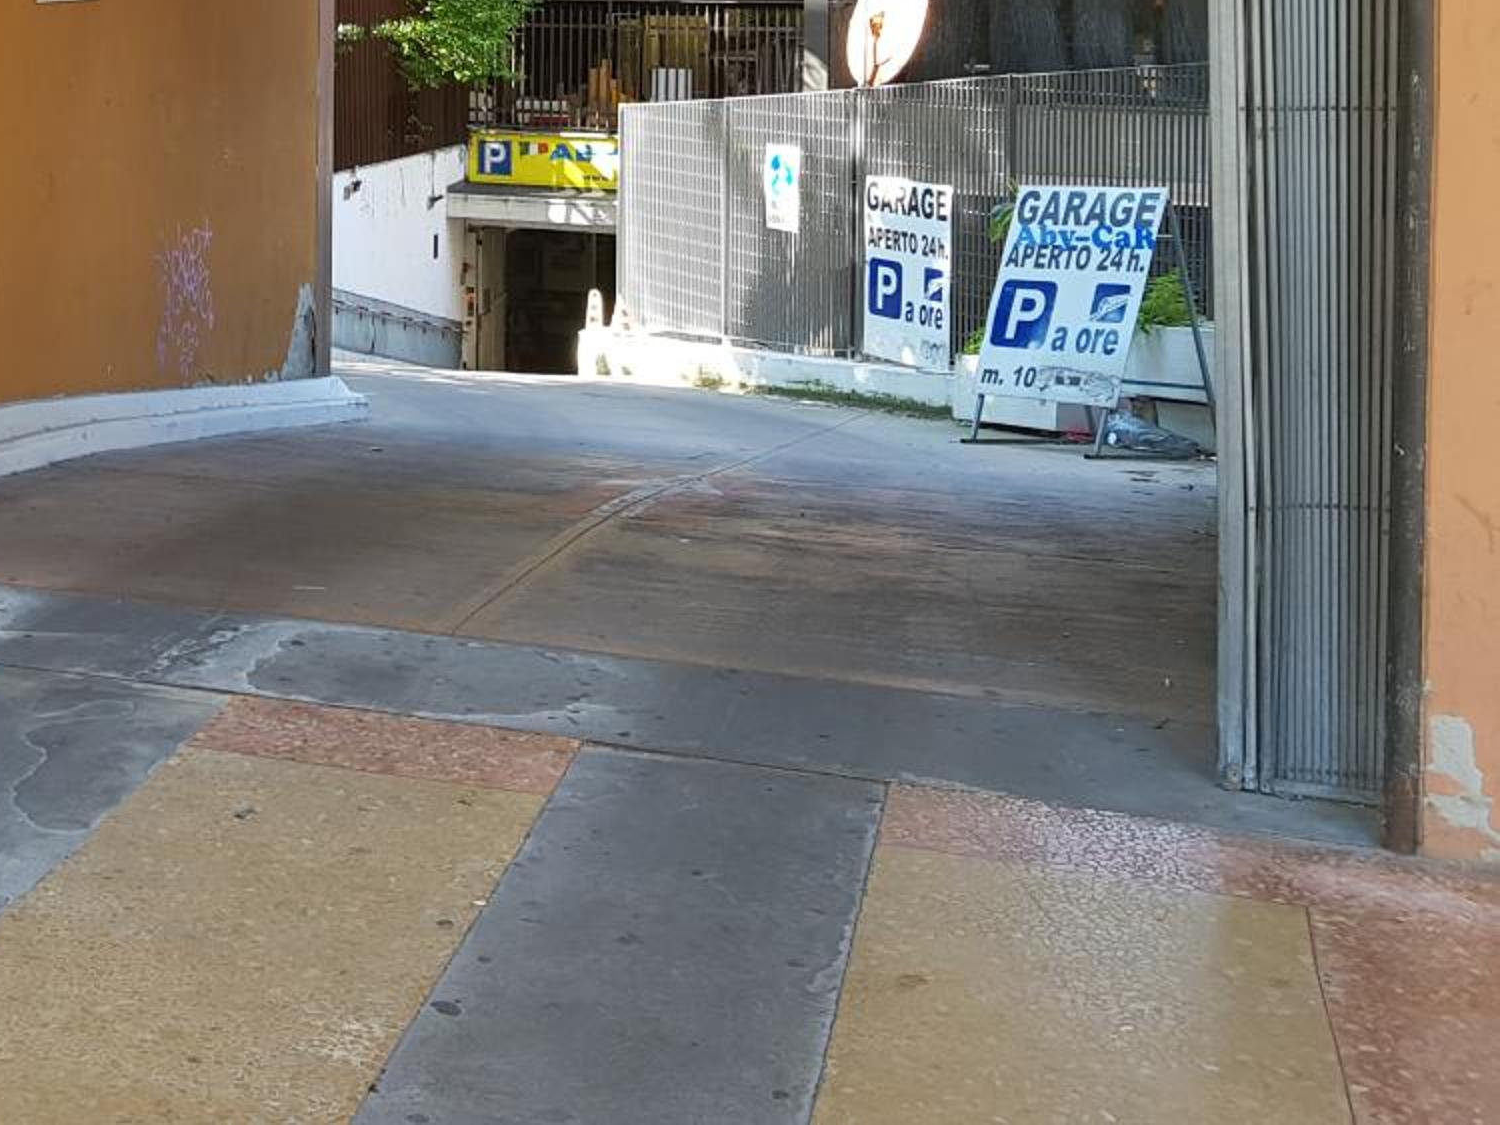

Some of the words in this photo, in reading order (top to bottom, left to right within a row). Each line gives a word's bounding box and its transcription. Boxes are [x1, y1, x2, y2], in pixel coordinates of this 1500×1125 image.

[483, 142, 507, 174] P
[867, 181, 948, 222] GARAGE
[1017, 190, 1161, 228] GARAGE
[867, 225, 918, 255] APERTO
[1004, 243, 1092, 271] APERTO
[876, 264, 898, 310] P
[905, 301, 915, 323] a
[919, 304, 943, 330] ore
[1005, 287, 1046, 340] P
[1050, 327, 1067, 352] a
[1075, 327, 1119, 356] ore
[981, 367, 1003, 386] m.
[1013, 366, 1037, 389] 10
